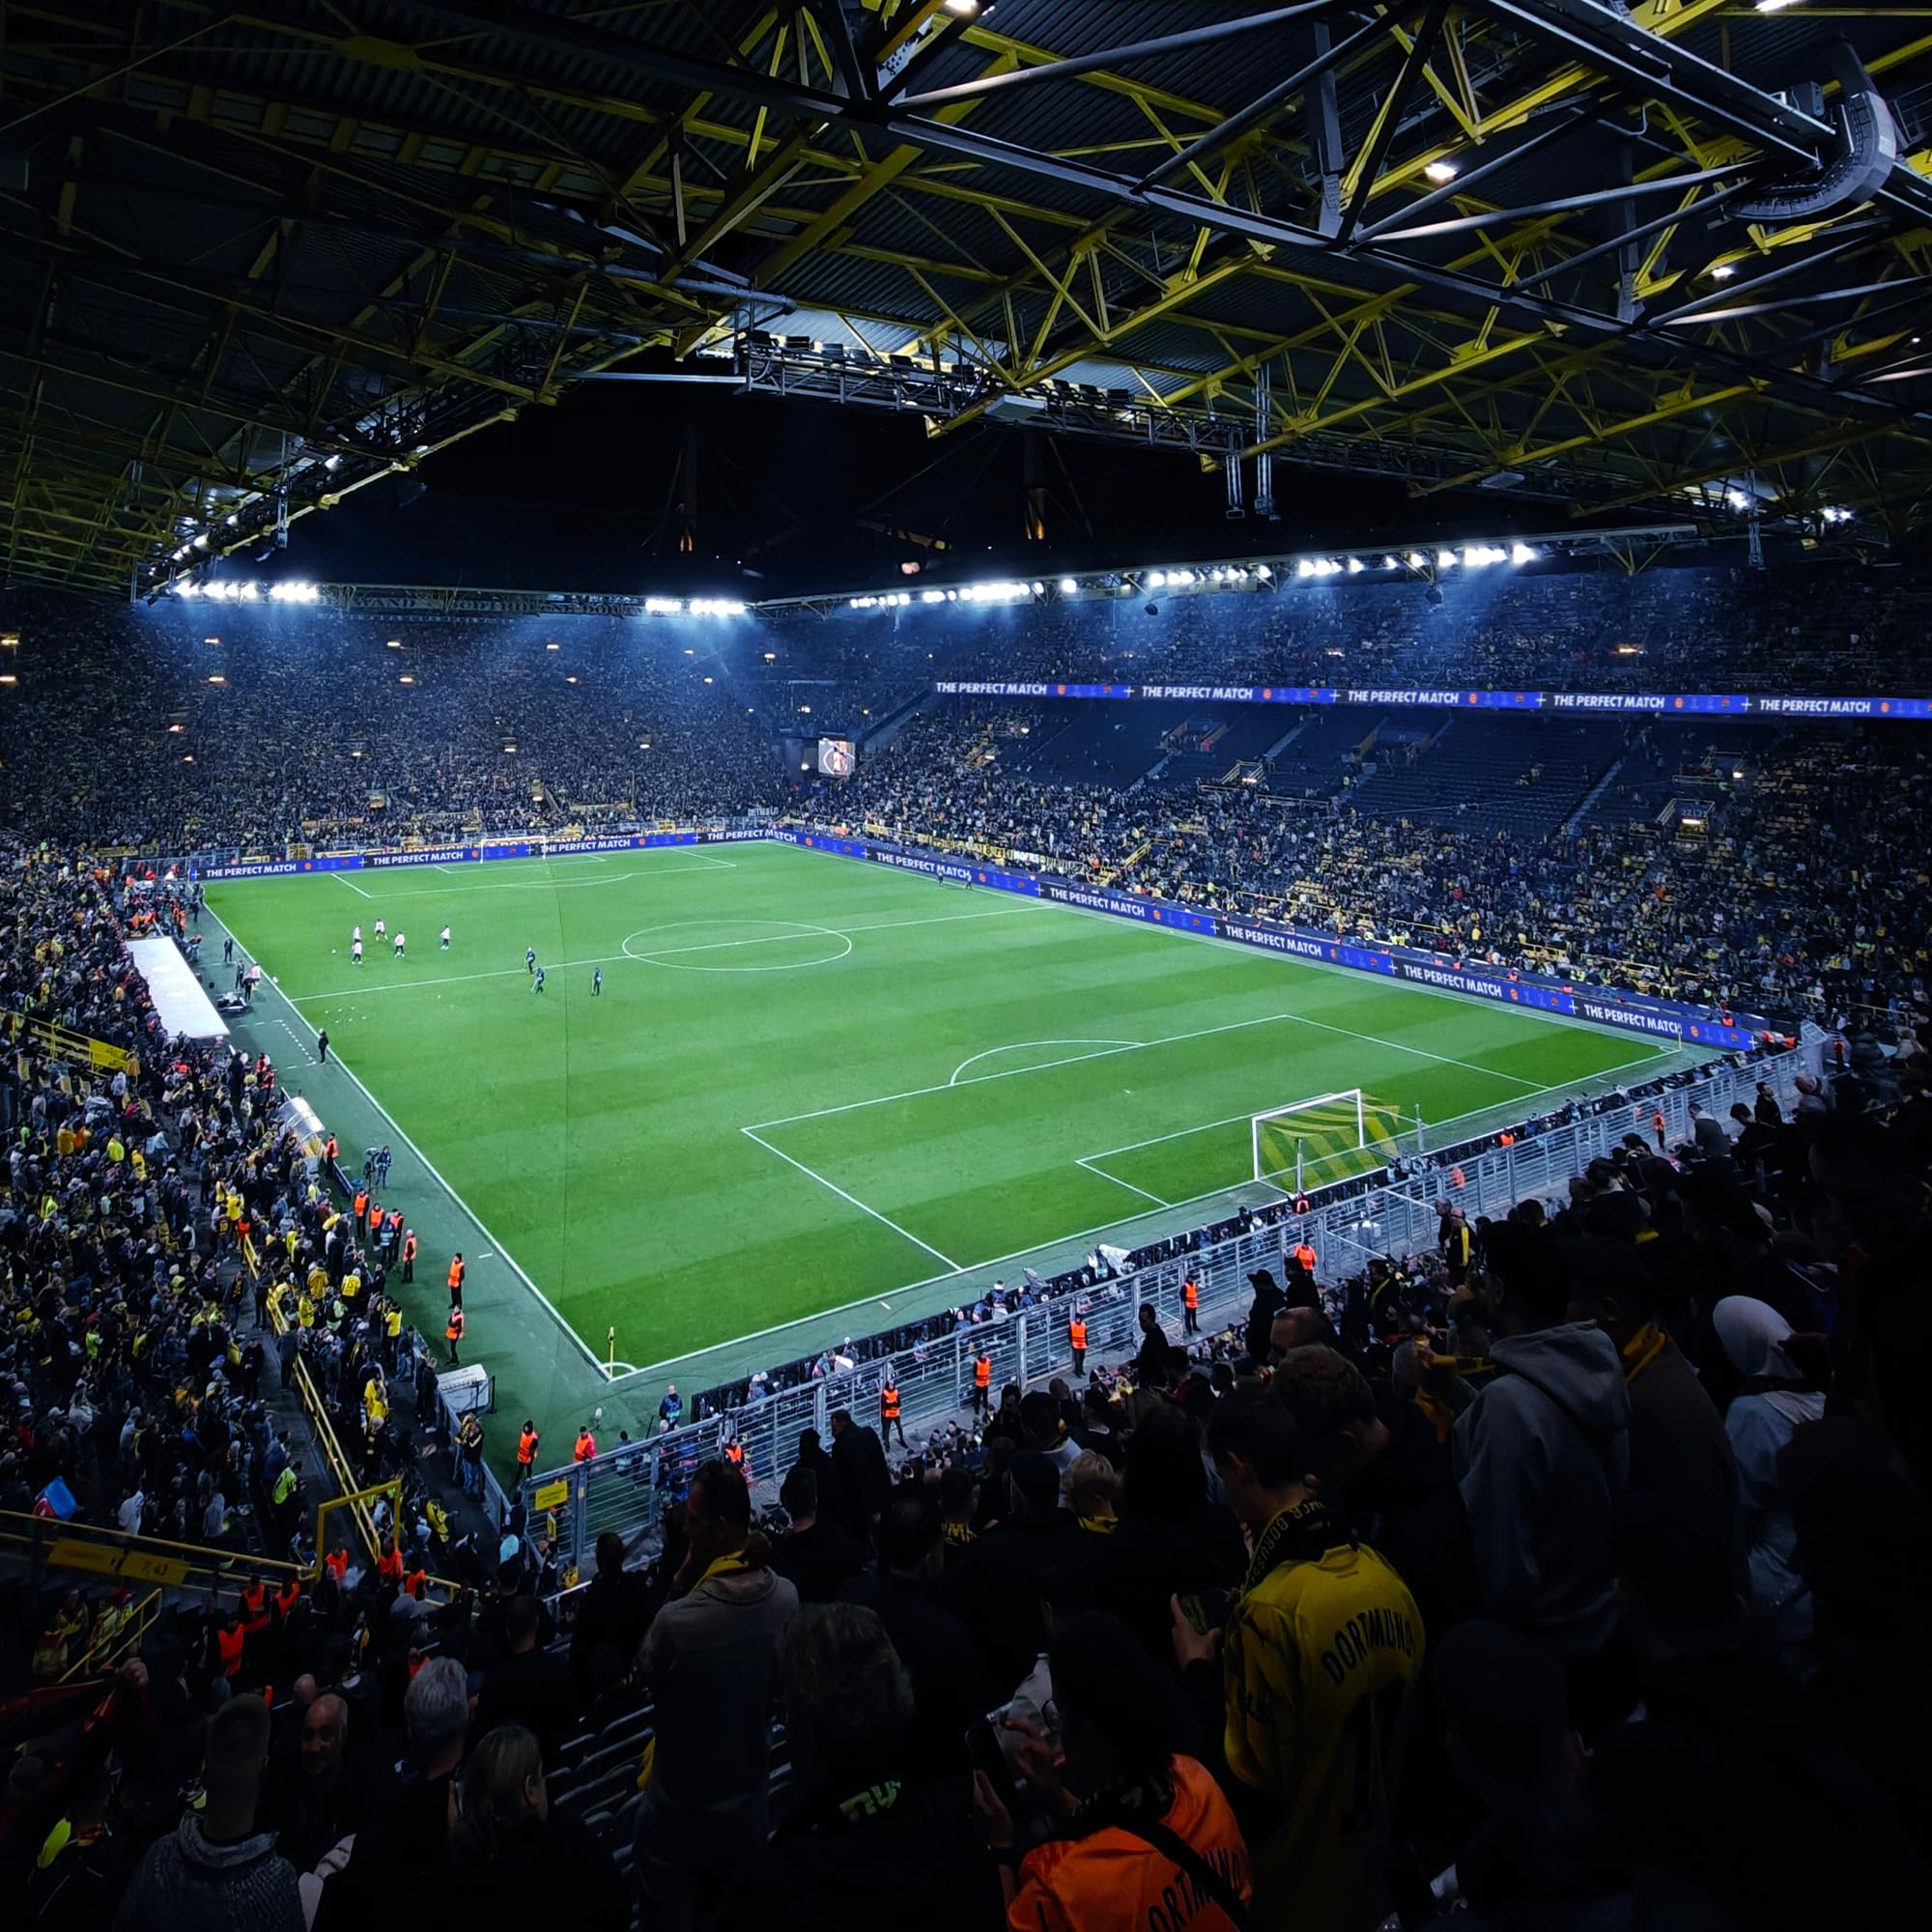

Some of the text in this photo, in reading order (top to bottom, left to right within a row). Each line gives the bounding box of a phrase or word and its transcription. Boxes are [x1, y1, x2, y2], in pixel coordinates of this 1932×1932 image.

[936, 682, 1047, 696] THE PERFECT MATCH
[1142, 686, 1253, 699] THE PERFECT MATCH
[1348, 691, 1460, 704] THE PERFECT MATCH
[1553, 695, 1664, 709] THE PERFECT MATCH
[1760, 699, 1870, 713] THE PERFECT MATCH
[707, 832, 724, 840] THE
[725, 830, 763, 839] PERFECT
[765, 829, 797, 842] MATCH
[558, 842, 596, 851] PERFECT
[598, 839, 631, 849] MATCH
[373, 852, 464, 866] THE PERFECT MATCH
[876, 852, 895, 865] THE
[895, 856, 935, 871] PERFECT
[206, 864, 297, 878] THE PERFECT MATCH
[1050, 888, 1145, 917] THE PERFECT MATCH
[1226, 925, 1321, 957] THE PERFECT MATCH
[1404, 964, 1502, 997] THE PERFECT MATCH
[1583, 1005, 1605, 1018] THE
[1605, 1008, 1645, 1027] PERFECT
[1321, 1607, 1415, 1685] DORTMUND
